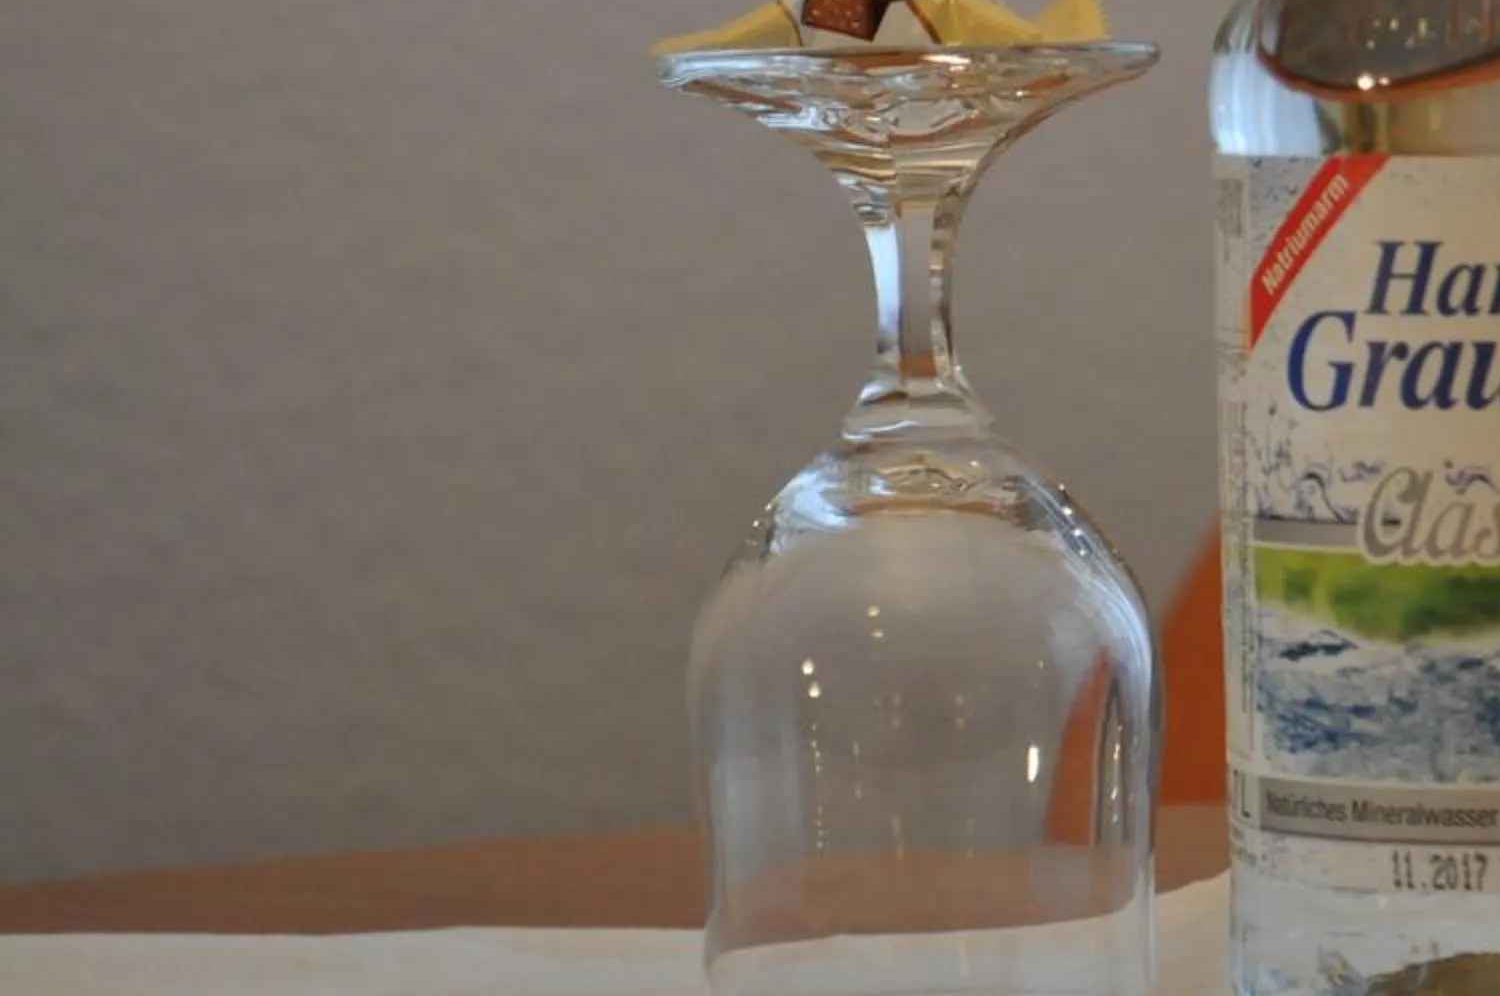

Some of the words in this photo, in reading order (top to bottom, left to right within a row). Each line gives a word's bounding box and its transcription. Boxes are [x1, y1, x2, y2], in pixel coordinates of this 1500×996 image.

[1261, 173, 1349, 296] Natriumarm
[1351, 799, 1499, 828] Mineralwasser
[1392, 850, 1488, 891] 11.2017
